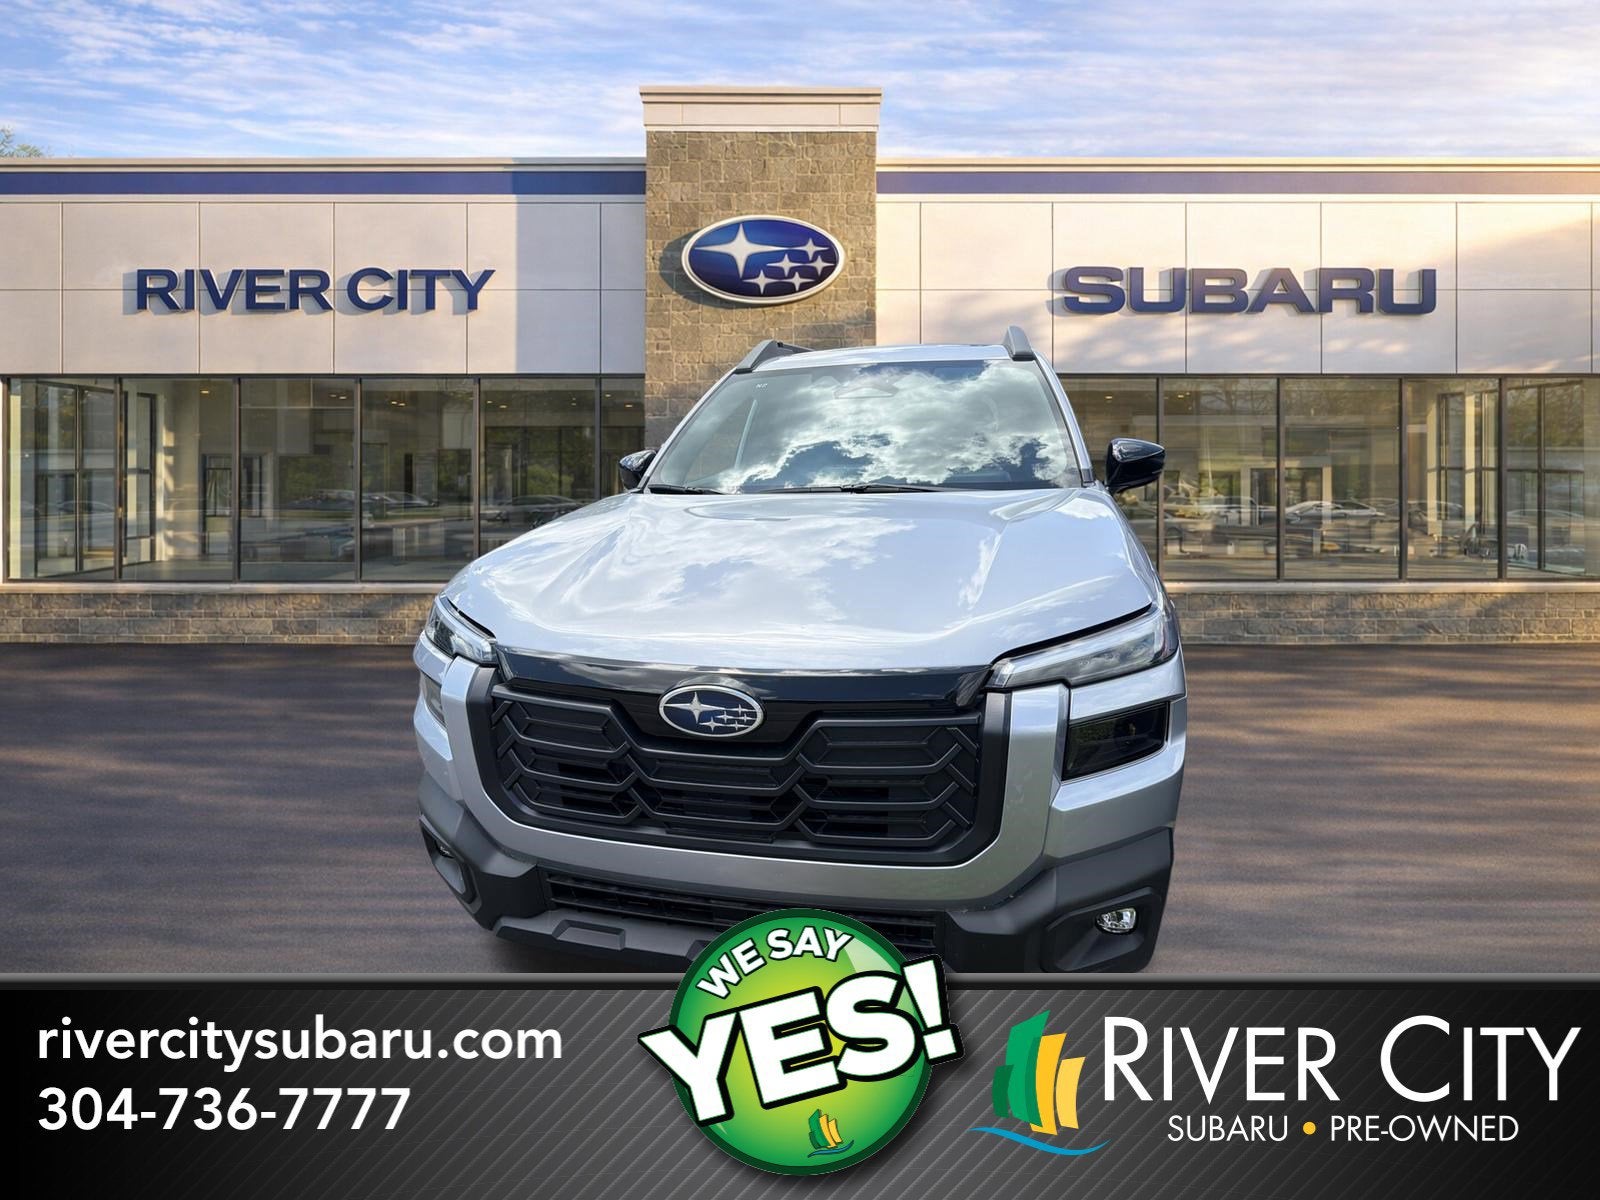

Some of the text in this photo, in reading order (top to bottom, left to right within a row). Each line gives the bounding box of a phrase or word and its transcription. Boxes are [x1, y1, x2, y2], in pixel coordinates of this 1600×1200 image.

[135, 267, 496, 311] RIVER CITY
[1062, 266, 1437, 315] SUBARU
